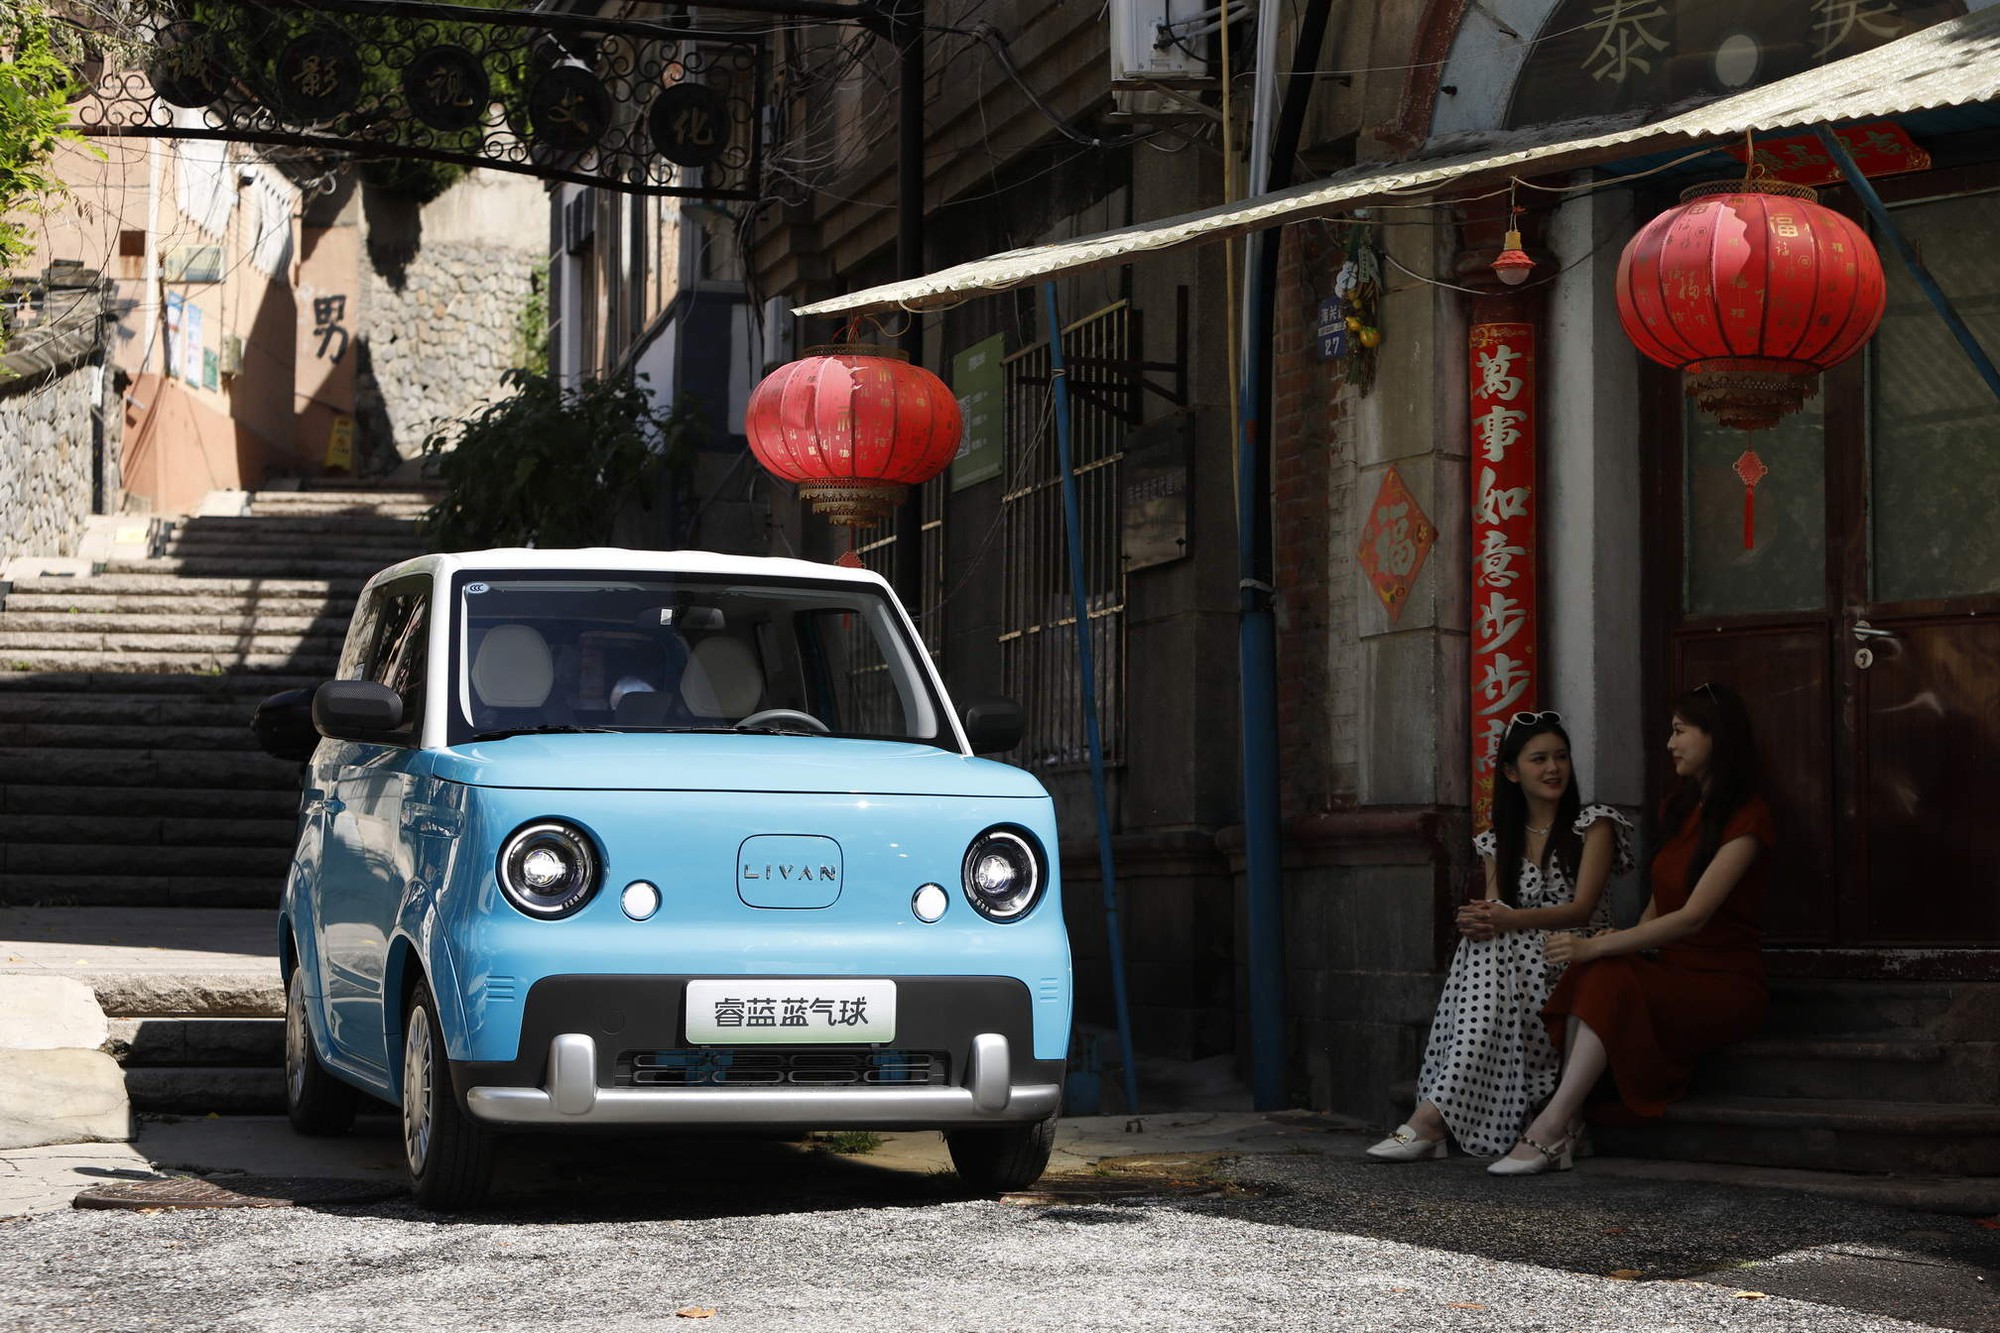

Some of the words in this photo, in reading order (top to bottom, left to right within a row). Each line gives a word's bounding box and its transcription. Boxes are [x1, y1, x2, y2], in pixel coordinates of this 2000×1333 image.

[313, 295, 349, 365] 男
[1324, 336, 1340, 356] 27
[1377, 501, 1416, 576] 福
[743, 864, 836, 881] LIVAN
[714, 996, 869, 1028] 睿蓝蓝气球
